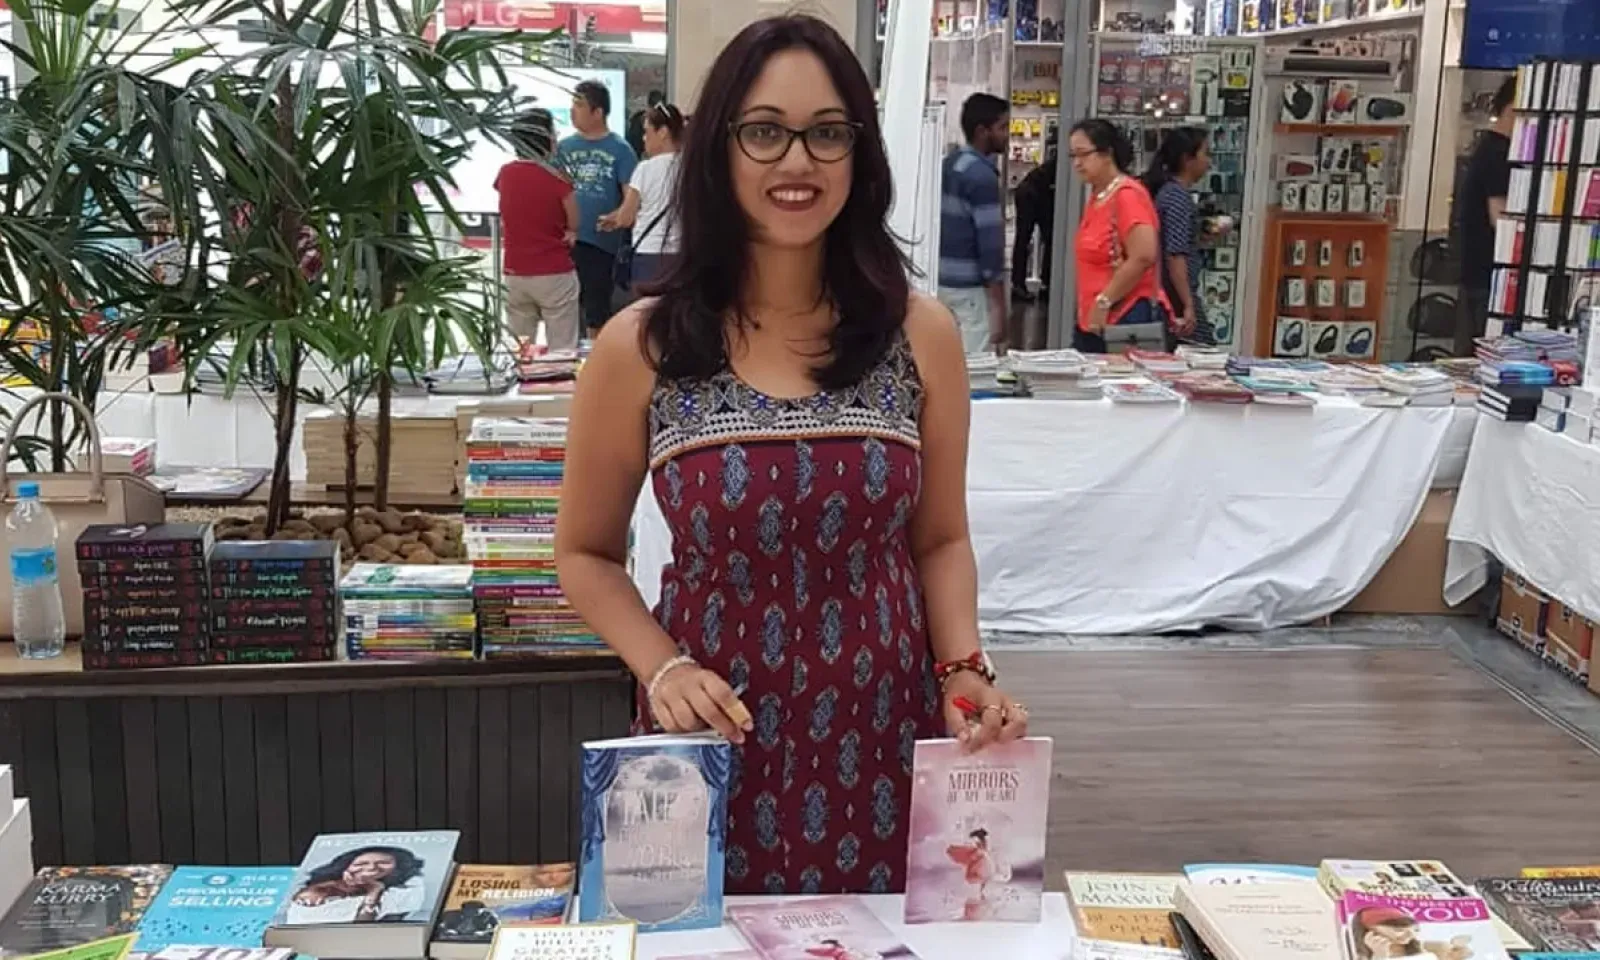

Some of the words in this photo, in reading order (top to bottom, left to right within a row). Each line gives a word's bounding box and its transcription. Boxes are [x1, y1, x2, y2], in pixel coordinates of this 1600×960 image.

[476, 2, 519, 26] LG
[949, 771, 1020, 790] MIRRORS
[41, 883, 121, 894] KARMA
[458, 879, 522, 890] LOSING
[1087, 880, 1147, 894] JOHN
[34, 893, 114, 905] KURRY
[456, 888, 480, 899] MY
[481, 887, 556, 900] RELIGION
[1080, 894, 1174, 905] MAXWE
[168, 896, 275, 908] SELLING
[1418, 900, 1454, 908] BEST
[1399, 906, 1481, 921] YOU
